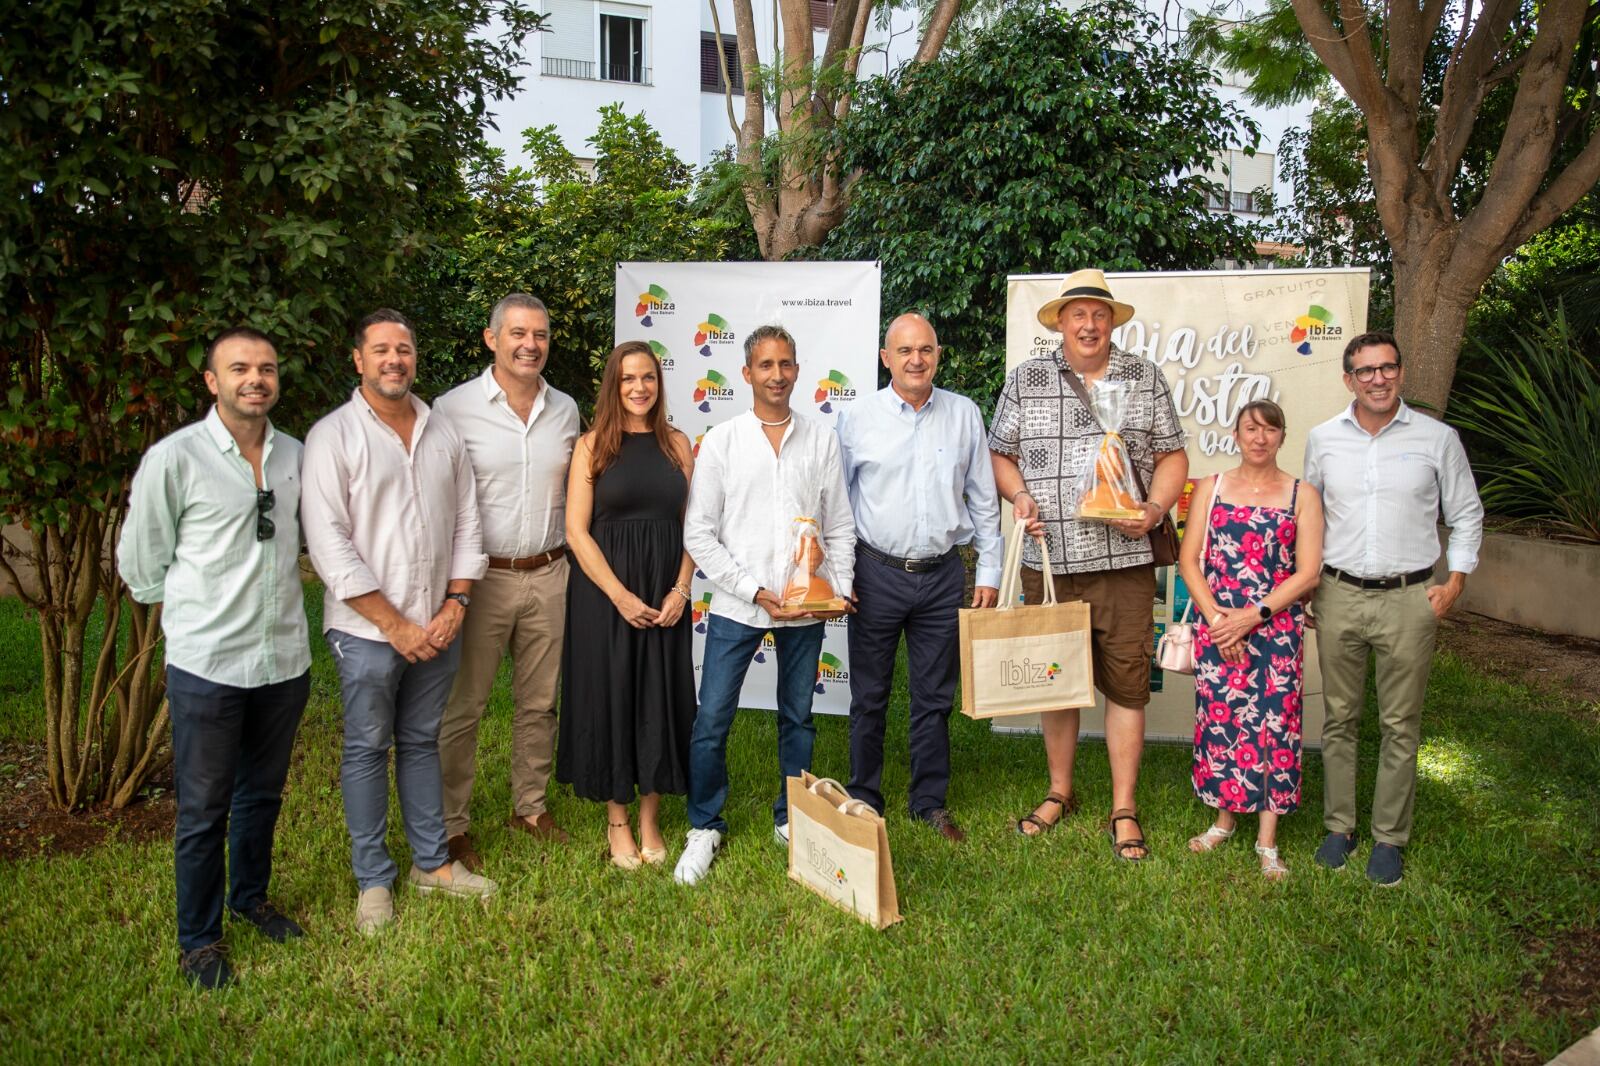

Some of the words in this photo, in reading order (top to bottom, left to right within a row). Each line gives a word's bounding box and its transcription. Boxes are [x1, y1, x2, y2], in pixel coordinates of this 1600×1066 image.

[1243, 278, 1327, 301] GRATUITO
[650, 301, 676, 311] Ibiza
[781, 298, 853, 307] www.ibiza.travel
[1263, 320, 1295, 333] VEN
[1309, 325, 1343, 335] Ibiza
[709, 330, 735, 340] Ibiza
[1207, 324, 1260, 360] del
[659, 356, 675, 366] iza
[708, 386, 734, 396] Ibiza
[830, 387, 856, 396] Ibiza
[1172, 362, 1281, 428] ista
[1199, 430, 1241, 457] Da
[822, 668, 849, 679] Ibiza
